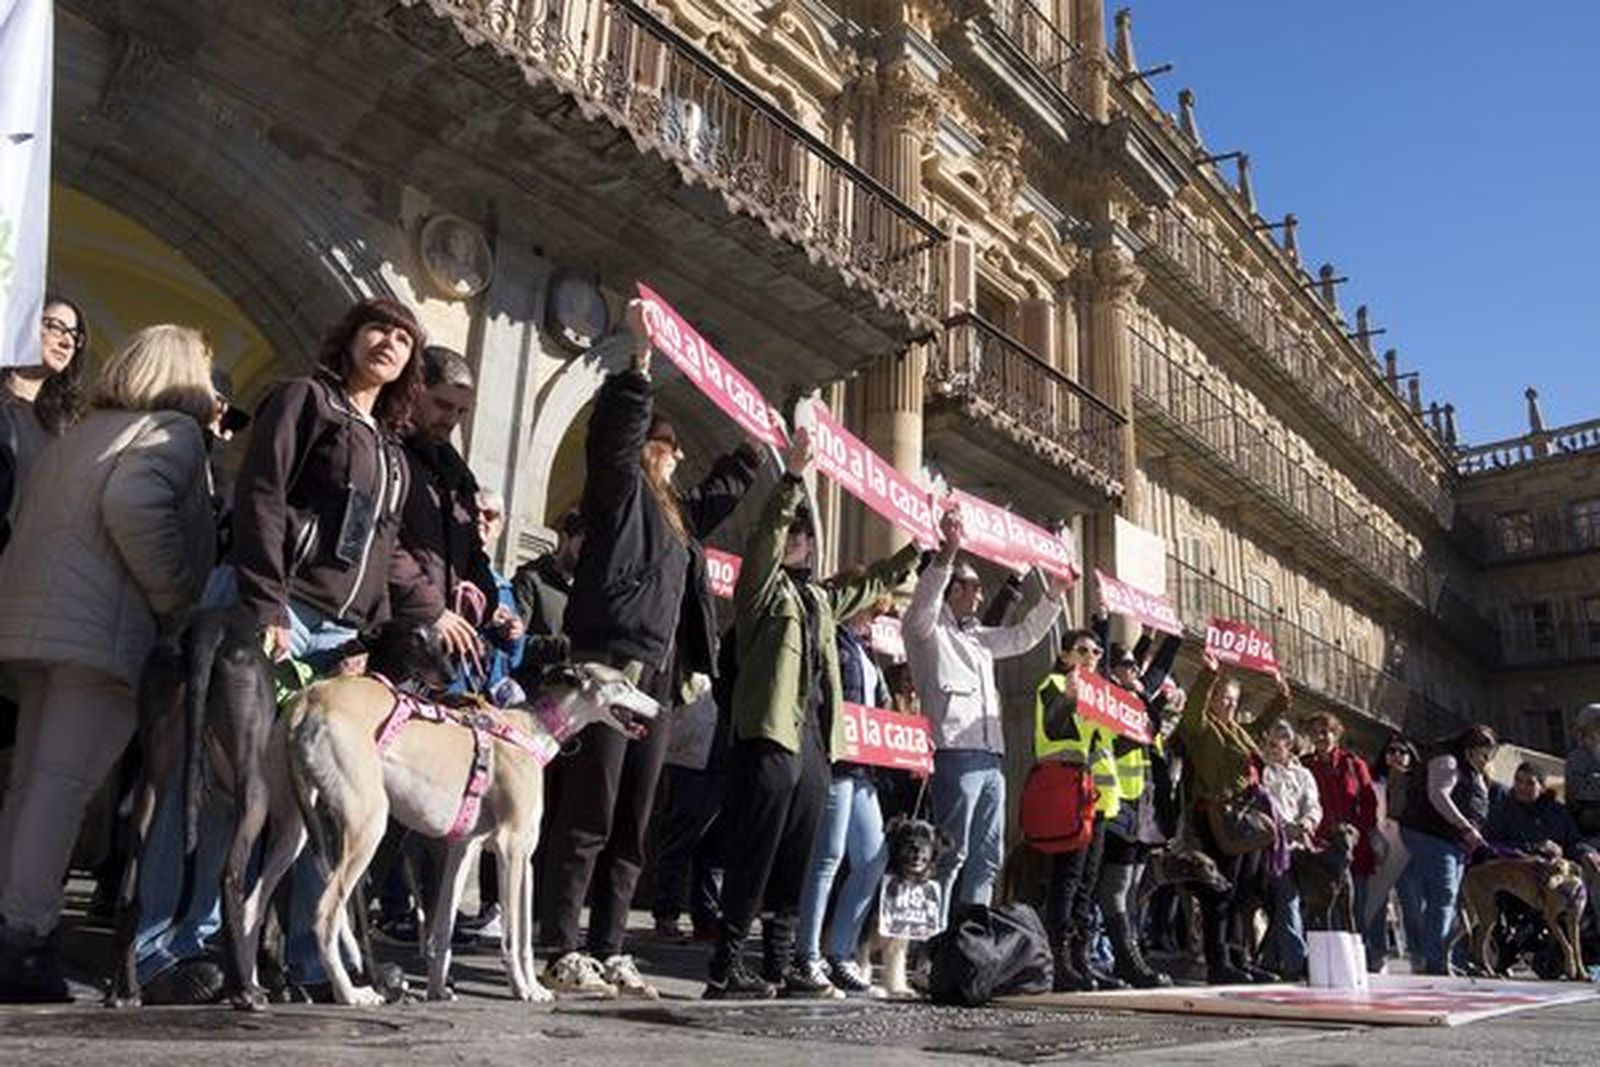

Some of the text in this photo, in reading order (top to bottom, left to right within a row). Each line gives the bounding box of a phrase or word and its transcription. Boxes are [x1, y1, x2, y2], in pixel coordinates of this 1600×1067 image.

[653, 303, 682, 350] no
[684, 333, 700, 367] a
[699, 336, 724, 390] la
[725, 373, 772, 430] caza
[818, 422, 847, 464] no
[849, 448, 864, 480] a
[865, 449, 887, 498] la
[889, 479, 933, 529] caza
[989, 514, 1006, 536] a
[1004, 511, 1026, 542] la
[707, 558, 734, 583] no
[1207, 626, 1234, 649] no
[1234, 634, 1247, 653] a
[1096, 687, 1105, 713] a
[1105, 684, 1120, 720] la
[844, 706, 929, 755] a la caza
